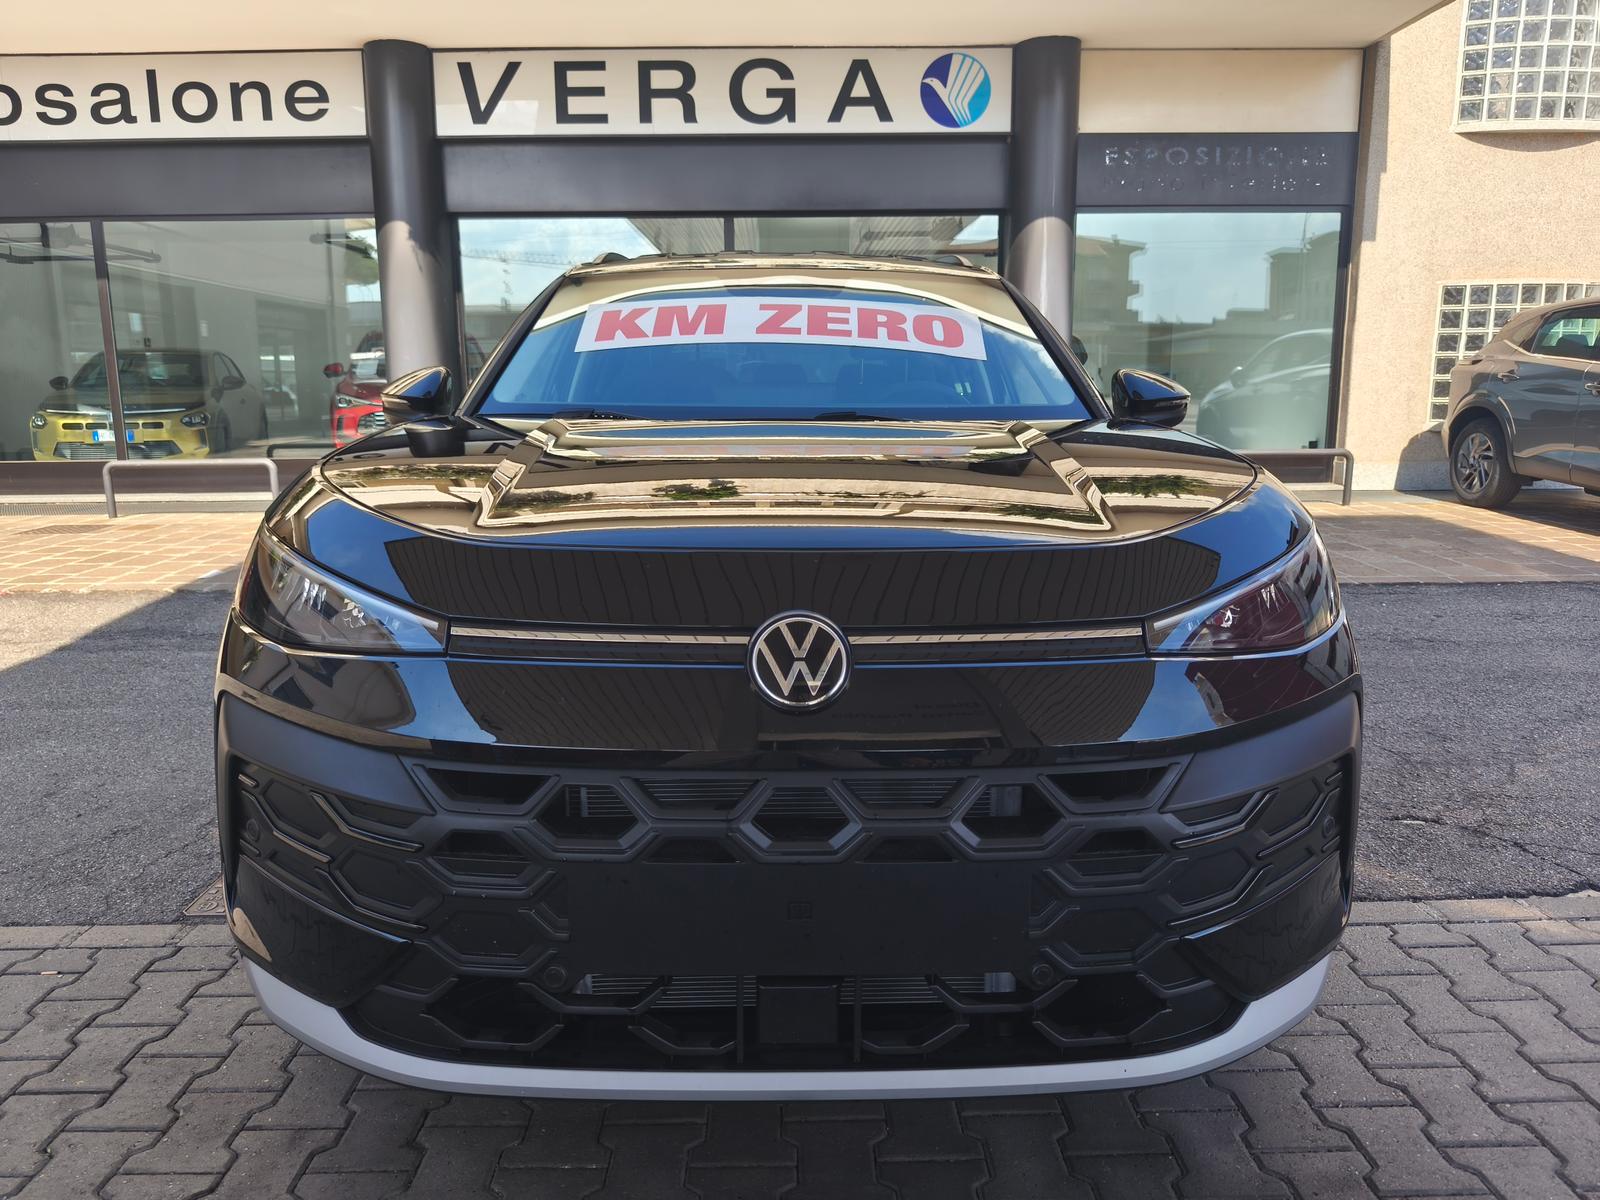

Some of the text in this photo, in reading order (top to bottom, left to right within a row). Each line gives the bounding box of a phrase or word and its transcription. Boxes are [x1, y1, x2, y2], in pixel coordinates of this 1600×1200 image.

[456, 57, 894, 125] VERGA
[594, 303, 965, 348] KM ZERO
